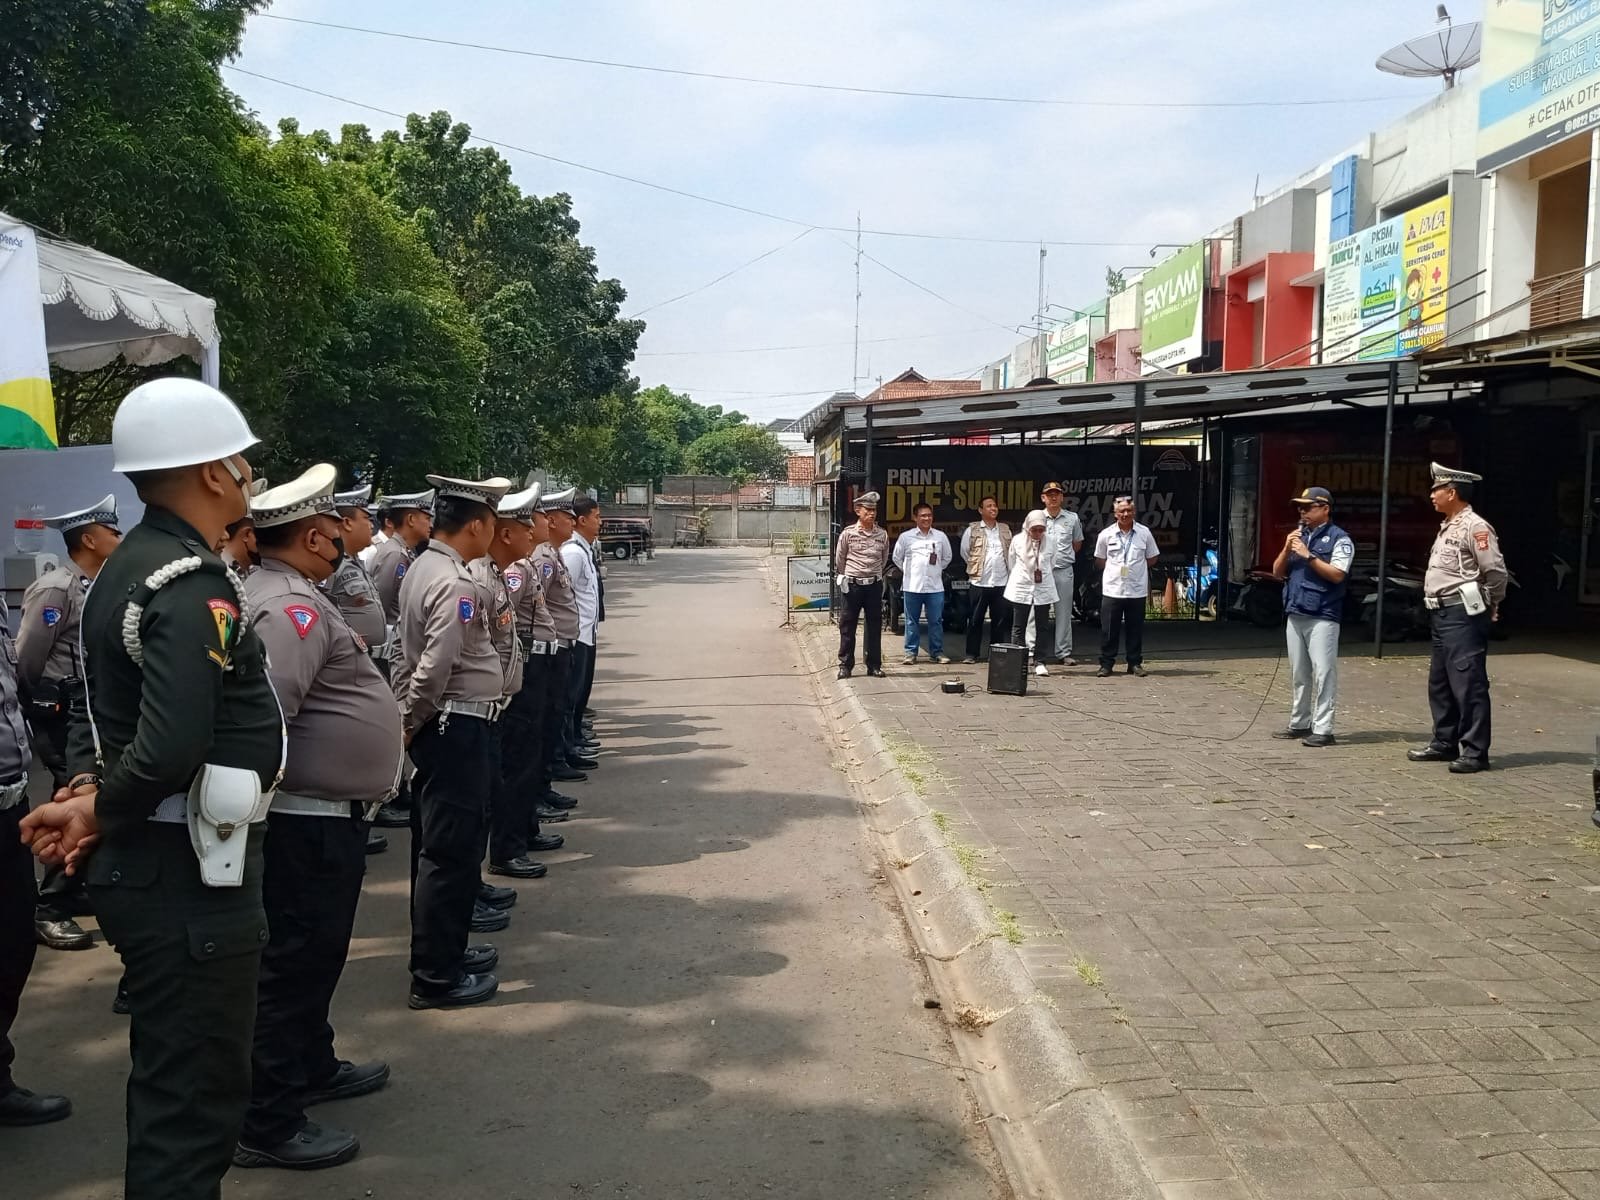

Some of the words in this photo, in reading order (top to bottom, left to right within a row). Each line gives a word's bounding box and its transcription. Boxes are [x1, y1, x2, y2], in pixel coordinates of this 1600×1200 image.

[1508, 35, 1593, 93] SUPERMARKET
[1541, 58, 1591, 95] MANUAL
[1537, 94, 1575, 124] CETAK
[1577, 81, 1600, 105] DTF
[1371, 225, 1394, 244] PKBM
[1364, 253, 1373, 265] AL
[1374, 242, 1400, 261] HIKAM
[1143, 264, 1198, 317] SKYLAM
[887, 468, 945, 485] PRINT
[1062, 476, 1158, 494] SUPERMARET
[1063, 491, 1174, 514] BAN
[1082, 509, 1184, 531] AON
